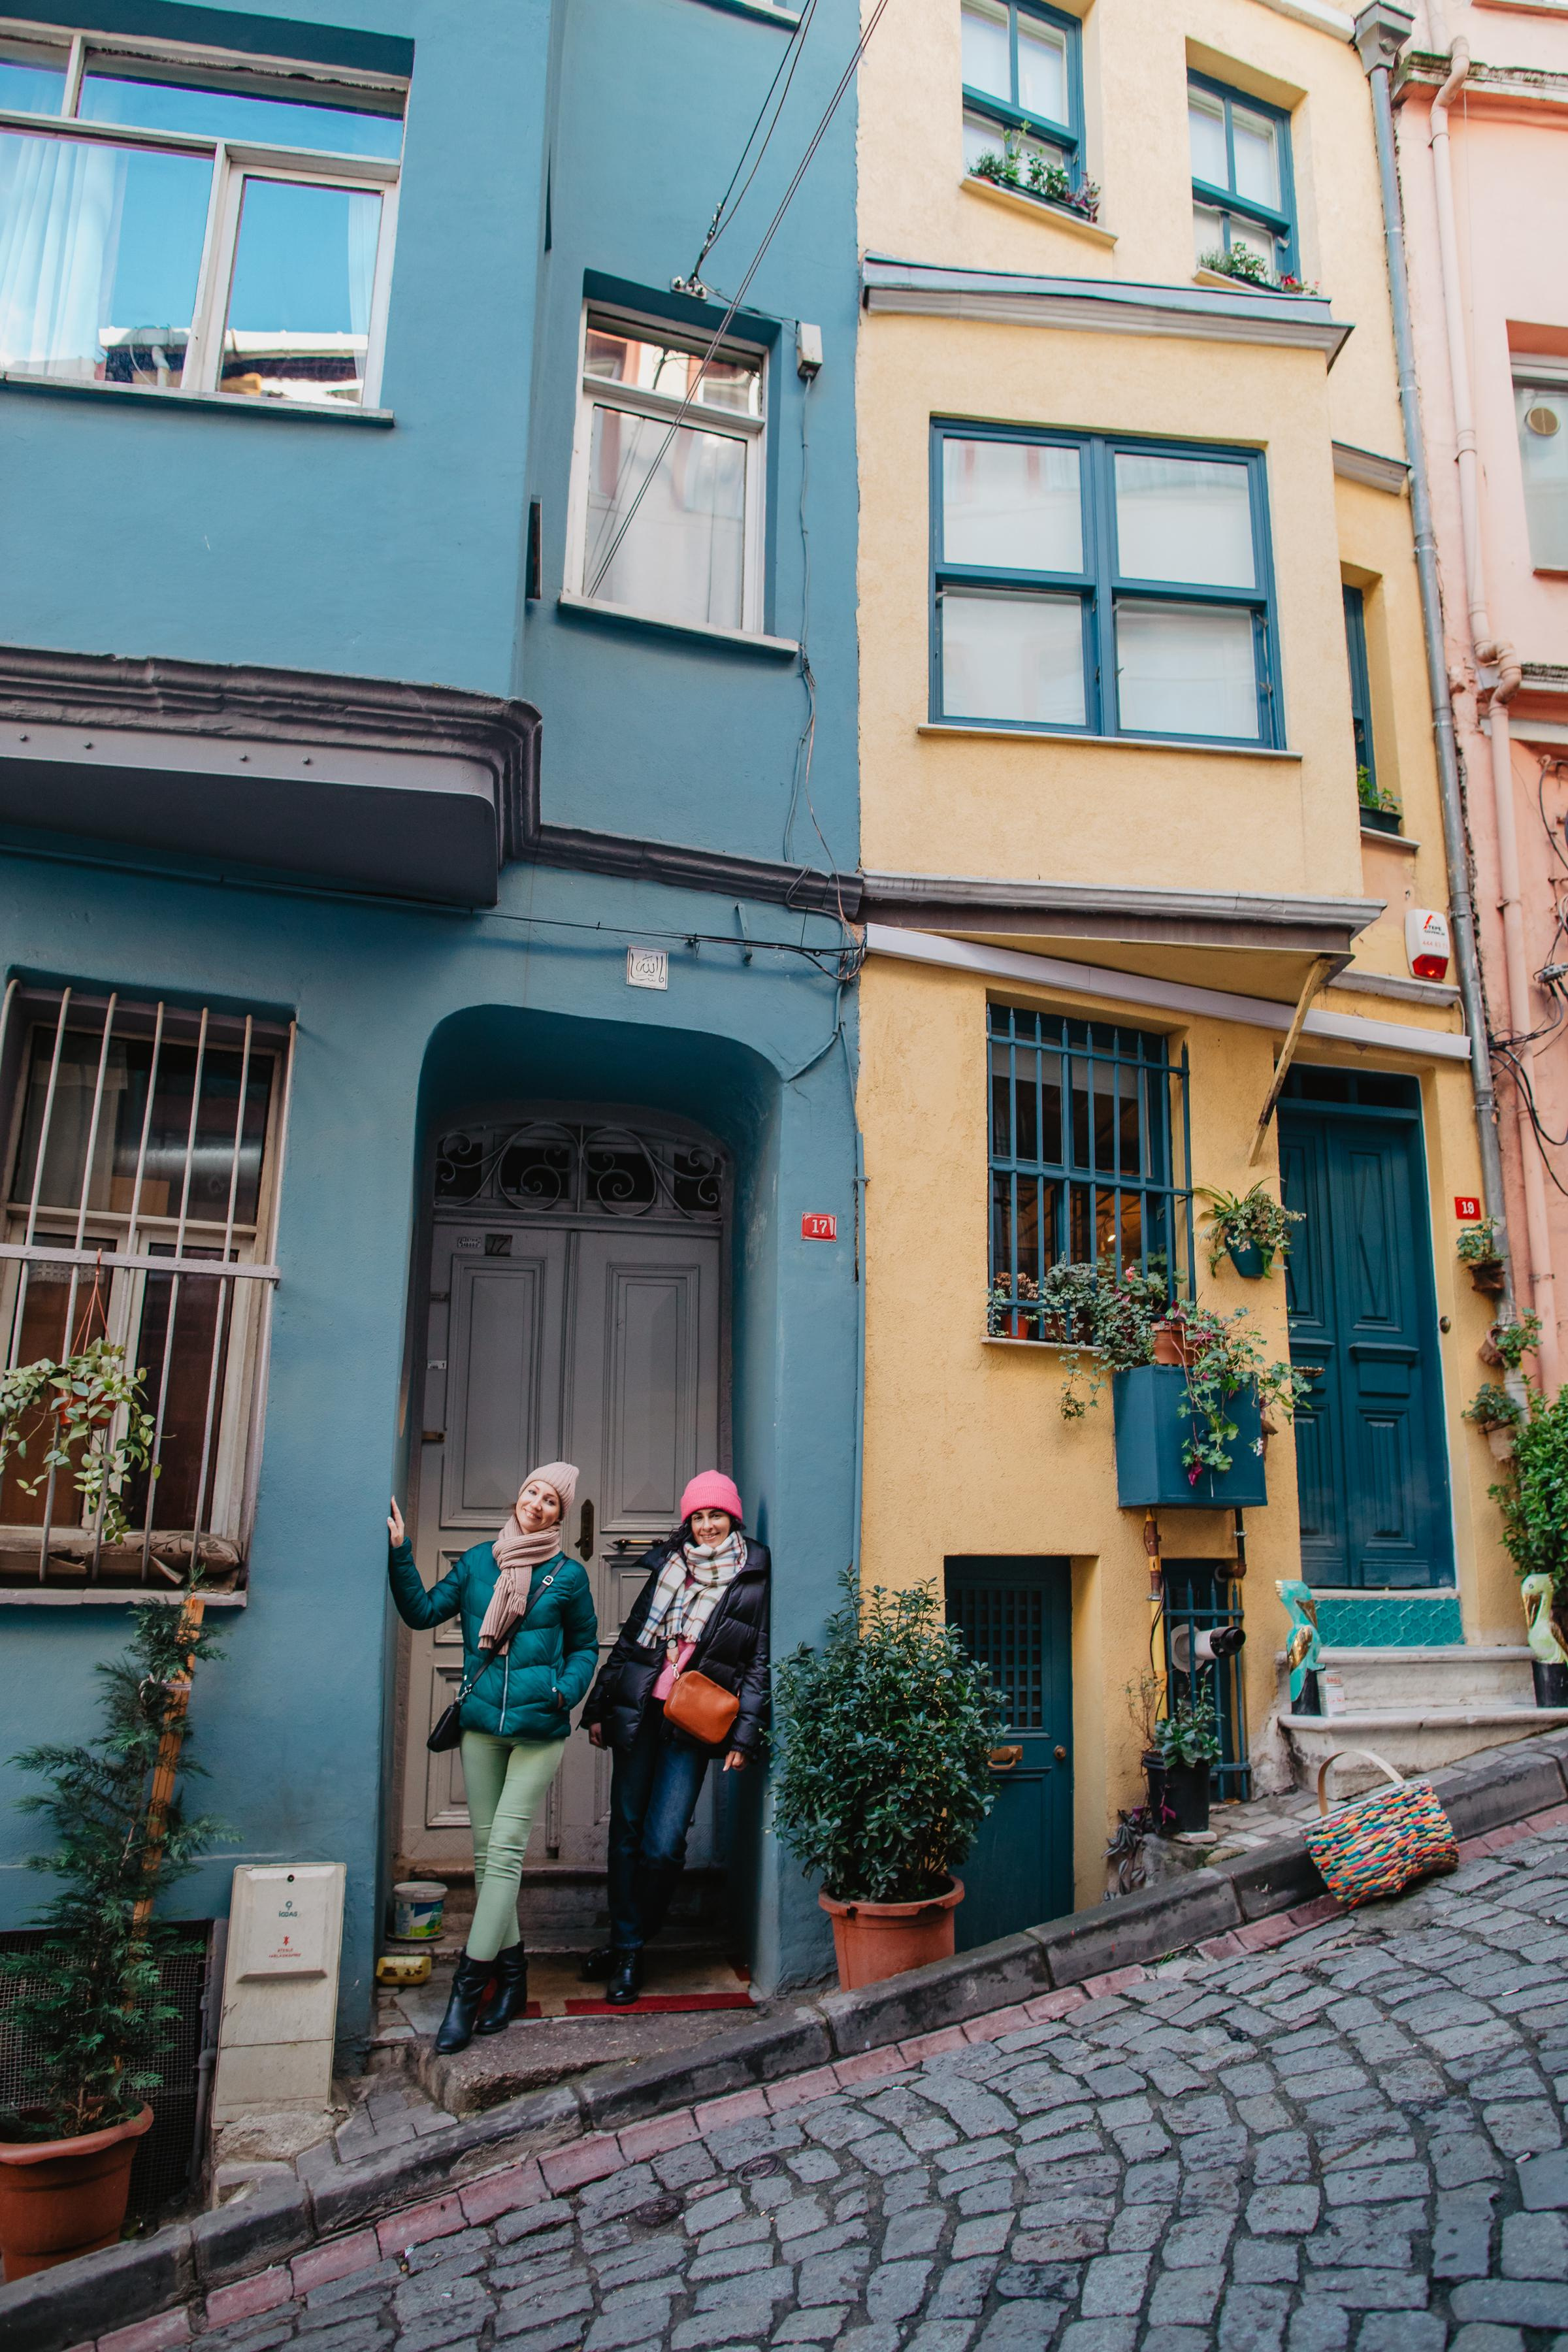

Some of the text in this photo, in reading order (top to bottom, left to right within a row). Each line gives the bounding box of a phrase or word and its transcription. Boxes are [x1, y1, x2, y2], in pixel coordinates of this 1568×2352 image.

[1462, 1201, 1475, 1215] 19
[812, 1219, 827, 1233] 17
[490, 1237, 509, 1253] 17
